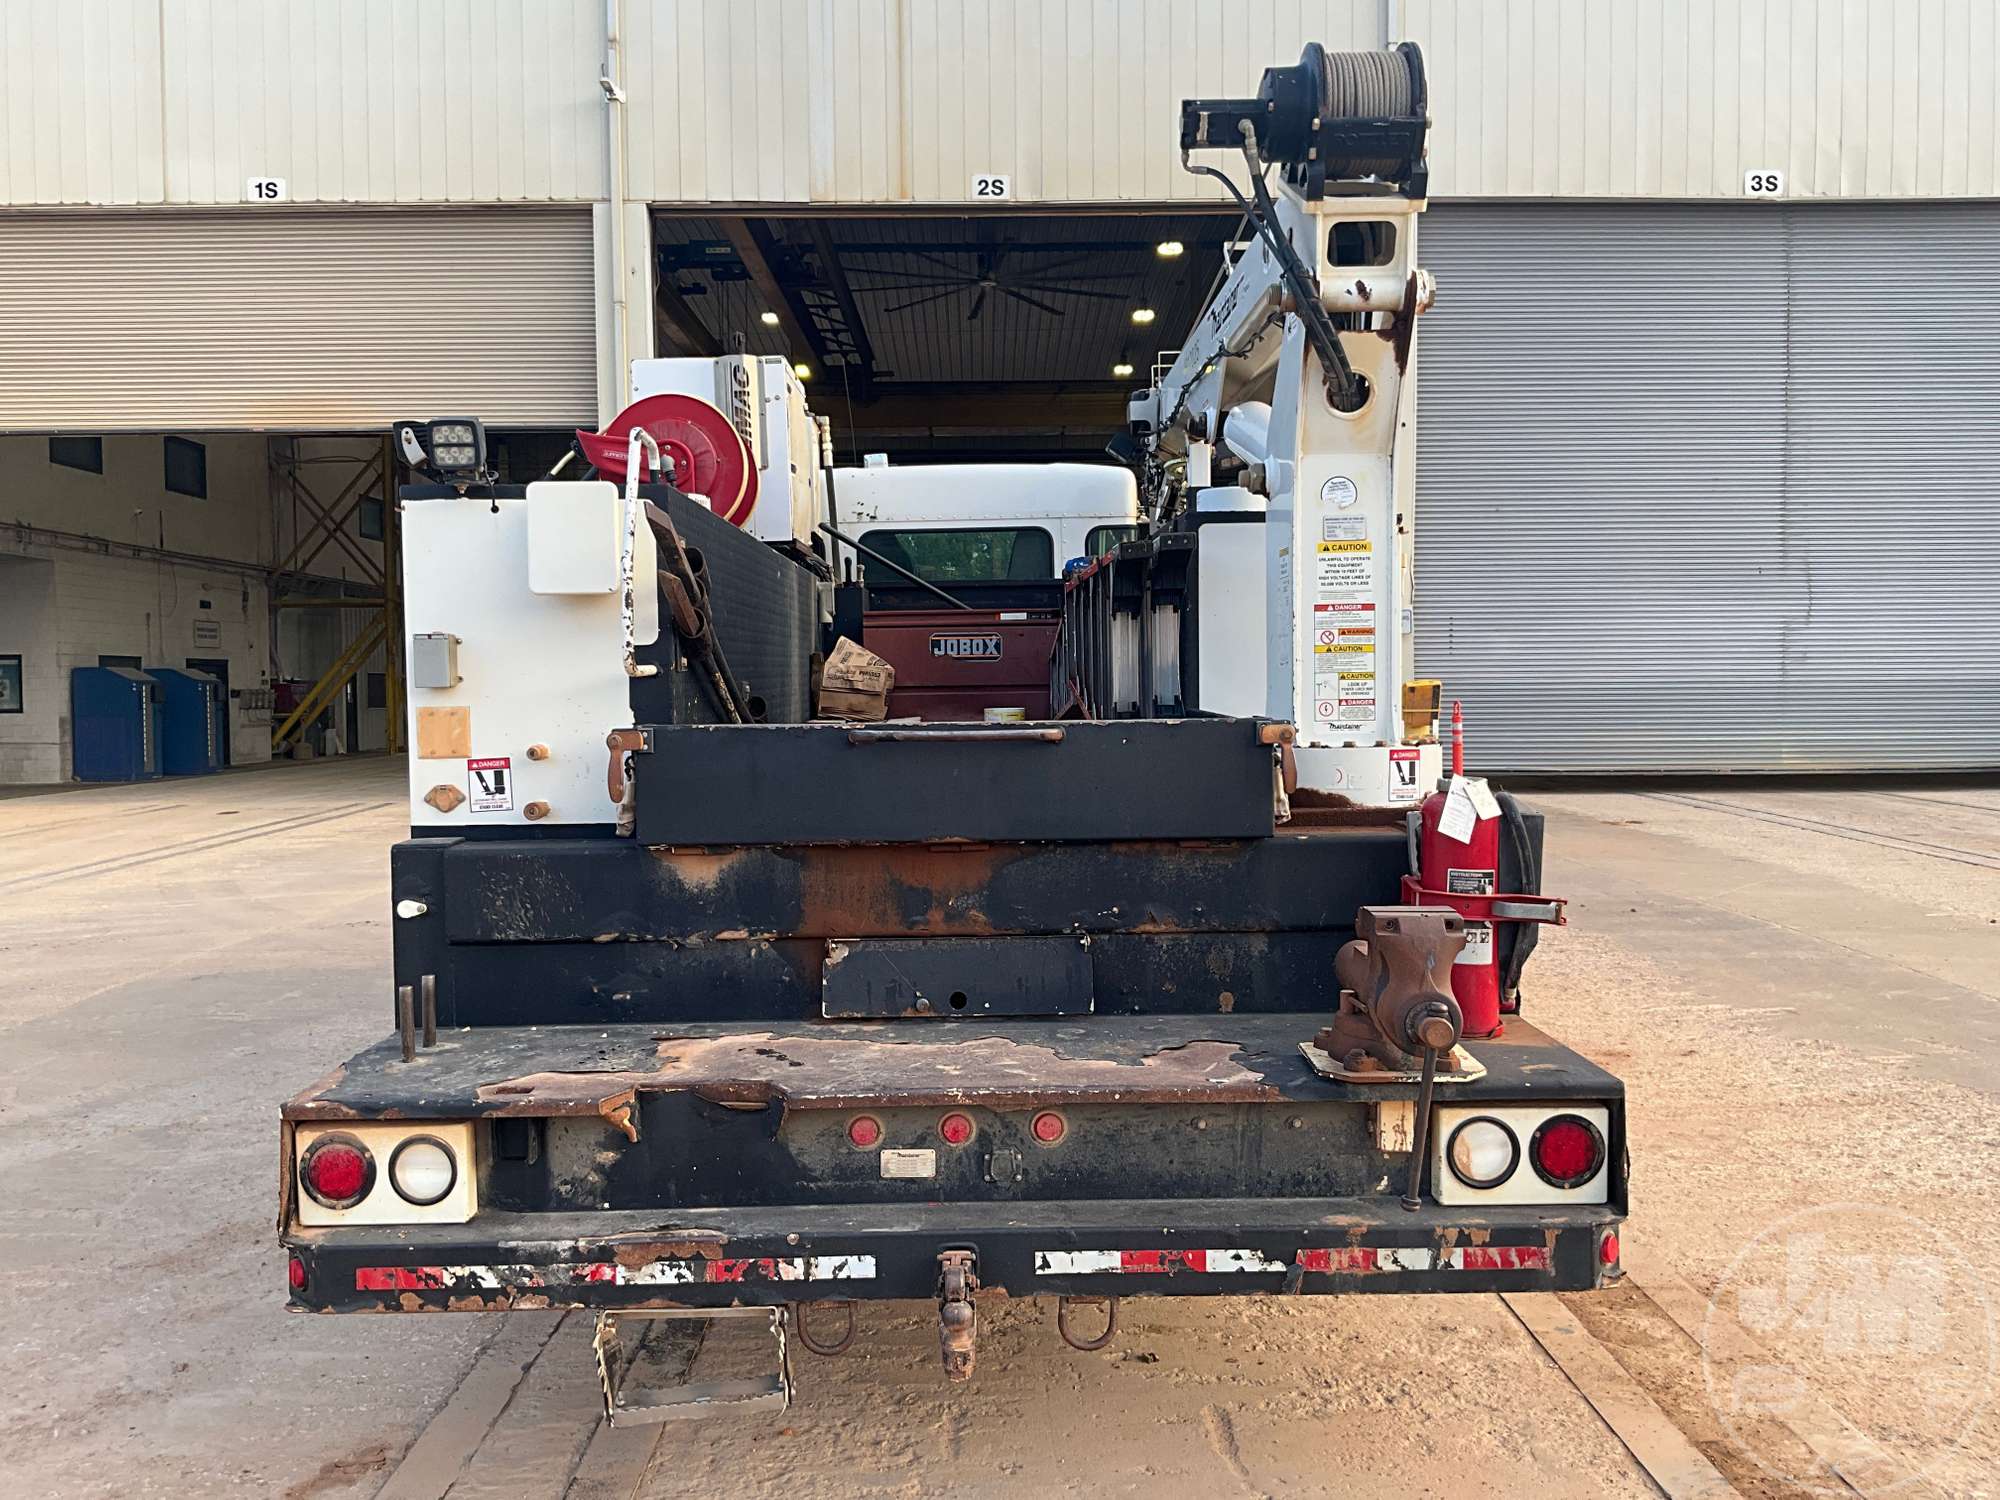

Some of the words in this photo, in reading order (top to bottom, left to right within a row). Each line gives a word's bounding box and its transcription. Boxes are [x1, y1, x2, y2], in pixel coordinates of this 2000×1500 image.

[254, 182, 278, 198] 1S
[978, 179, 1004, 196] 2S
[1751, 175, 1778, 192] 3S
[732, 364, 752, 449] MAC
[933, 638, 999, 656] JOBOX
[478, 760, 505, 768] DANGER
